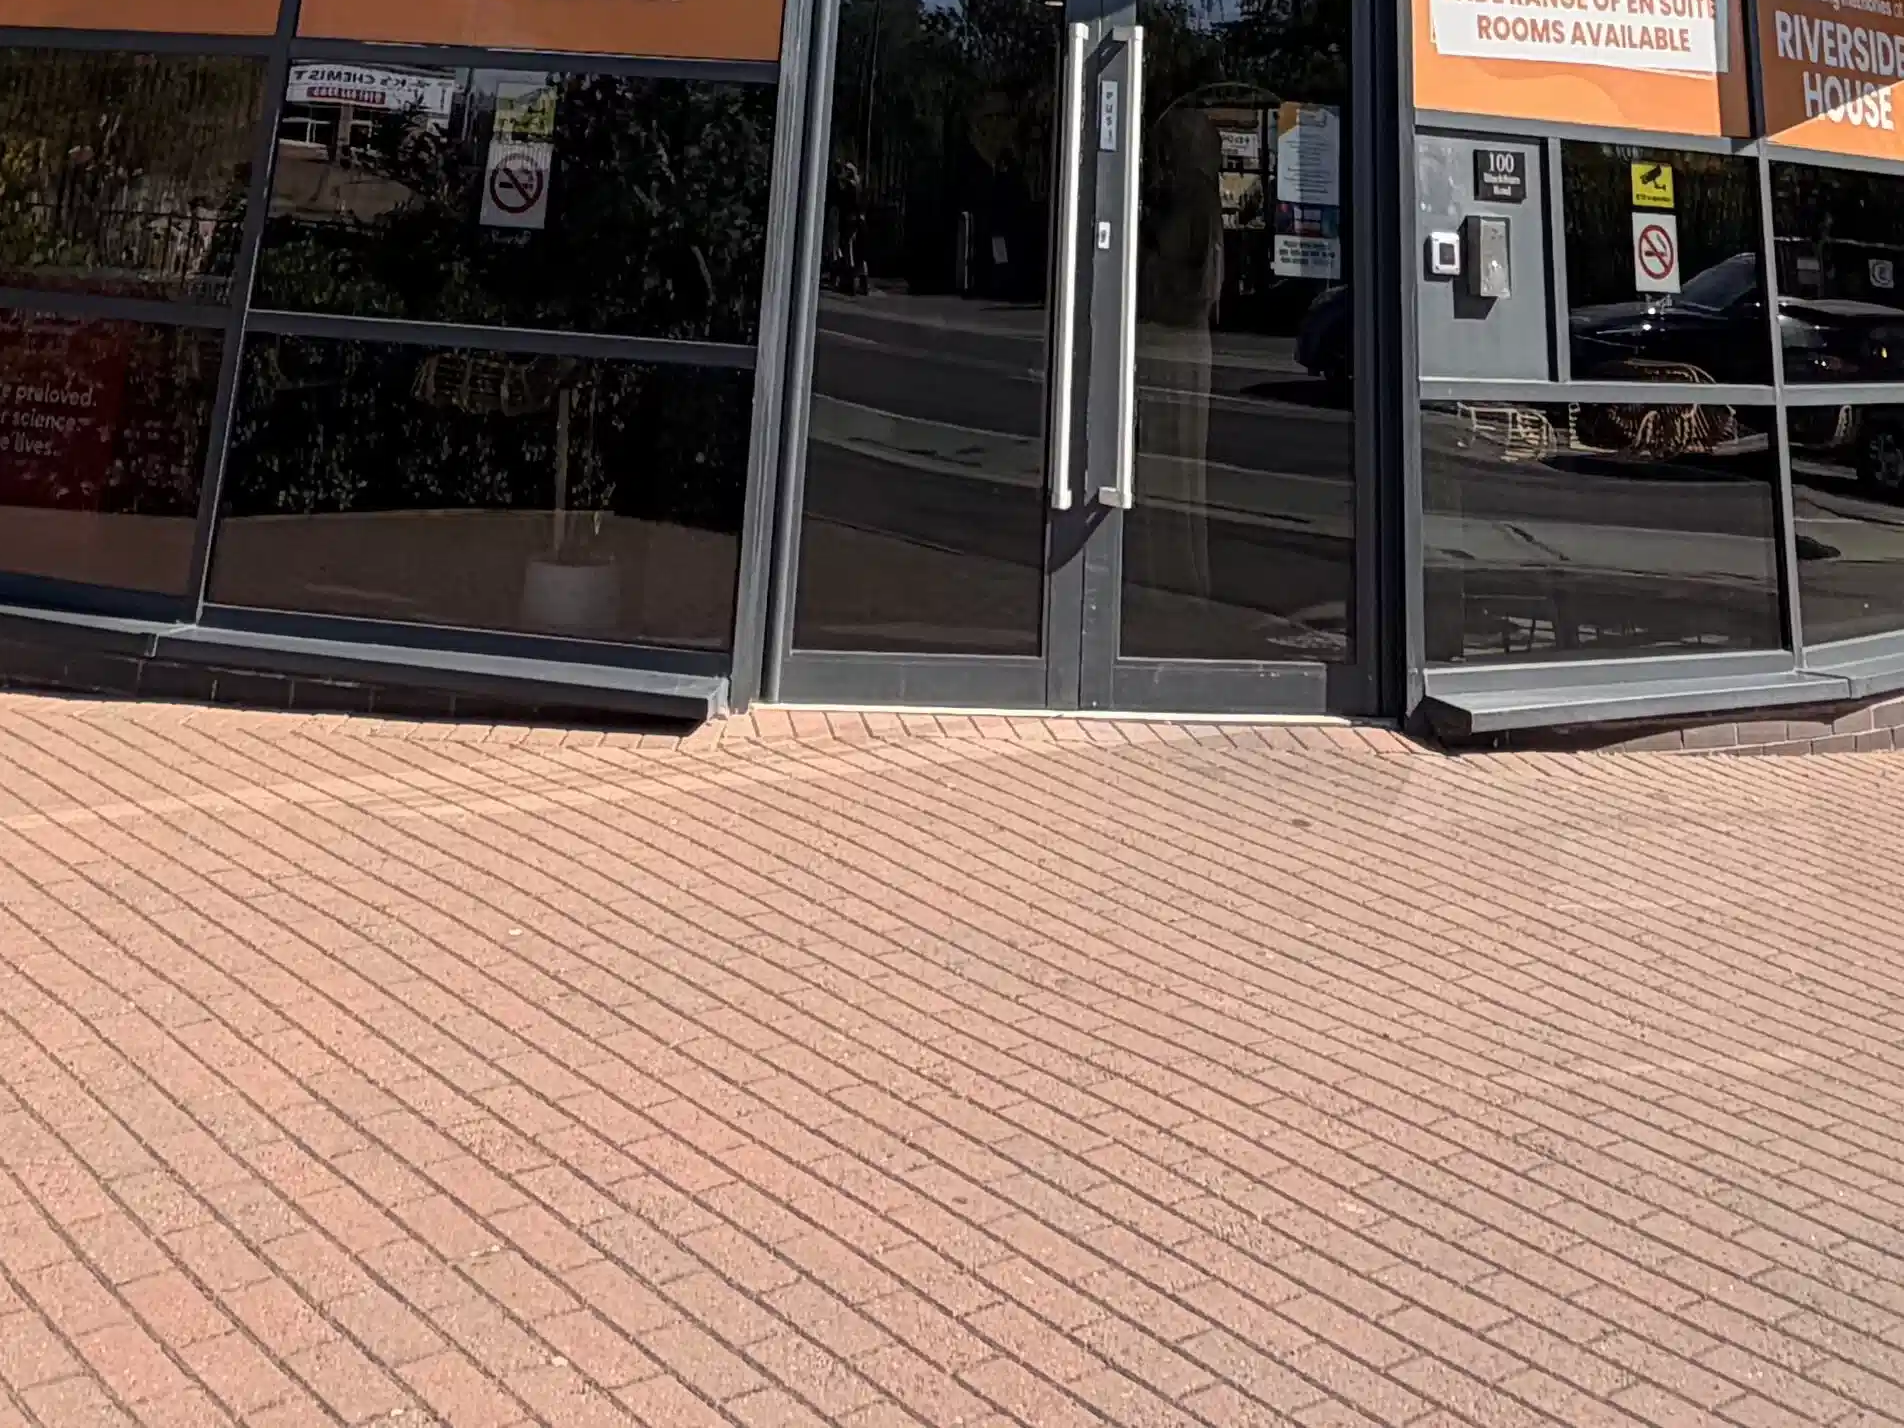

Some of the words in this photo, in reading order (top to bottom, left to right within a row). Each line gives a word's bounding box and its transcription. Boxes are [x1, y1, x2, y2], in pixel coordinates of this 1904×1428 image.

[1893, 0, 1904, 19] at
[1476, 13, 1565, 45] ROOMS
[1570, 20, 1692, 53] AVAILABLE
[1802, 70, 1895, 131] HOUSE
[1489, 151, 1515, 173] 100
